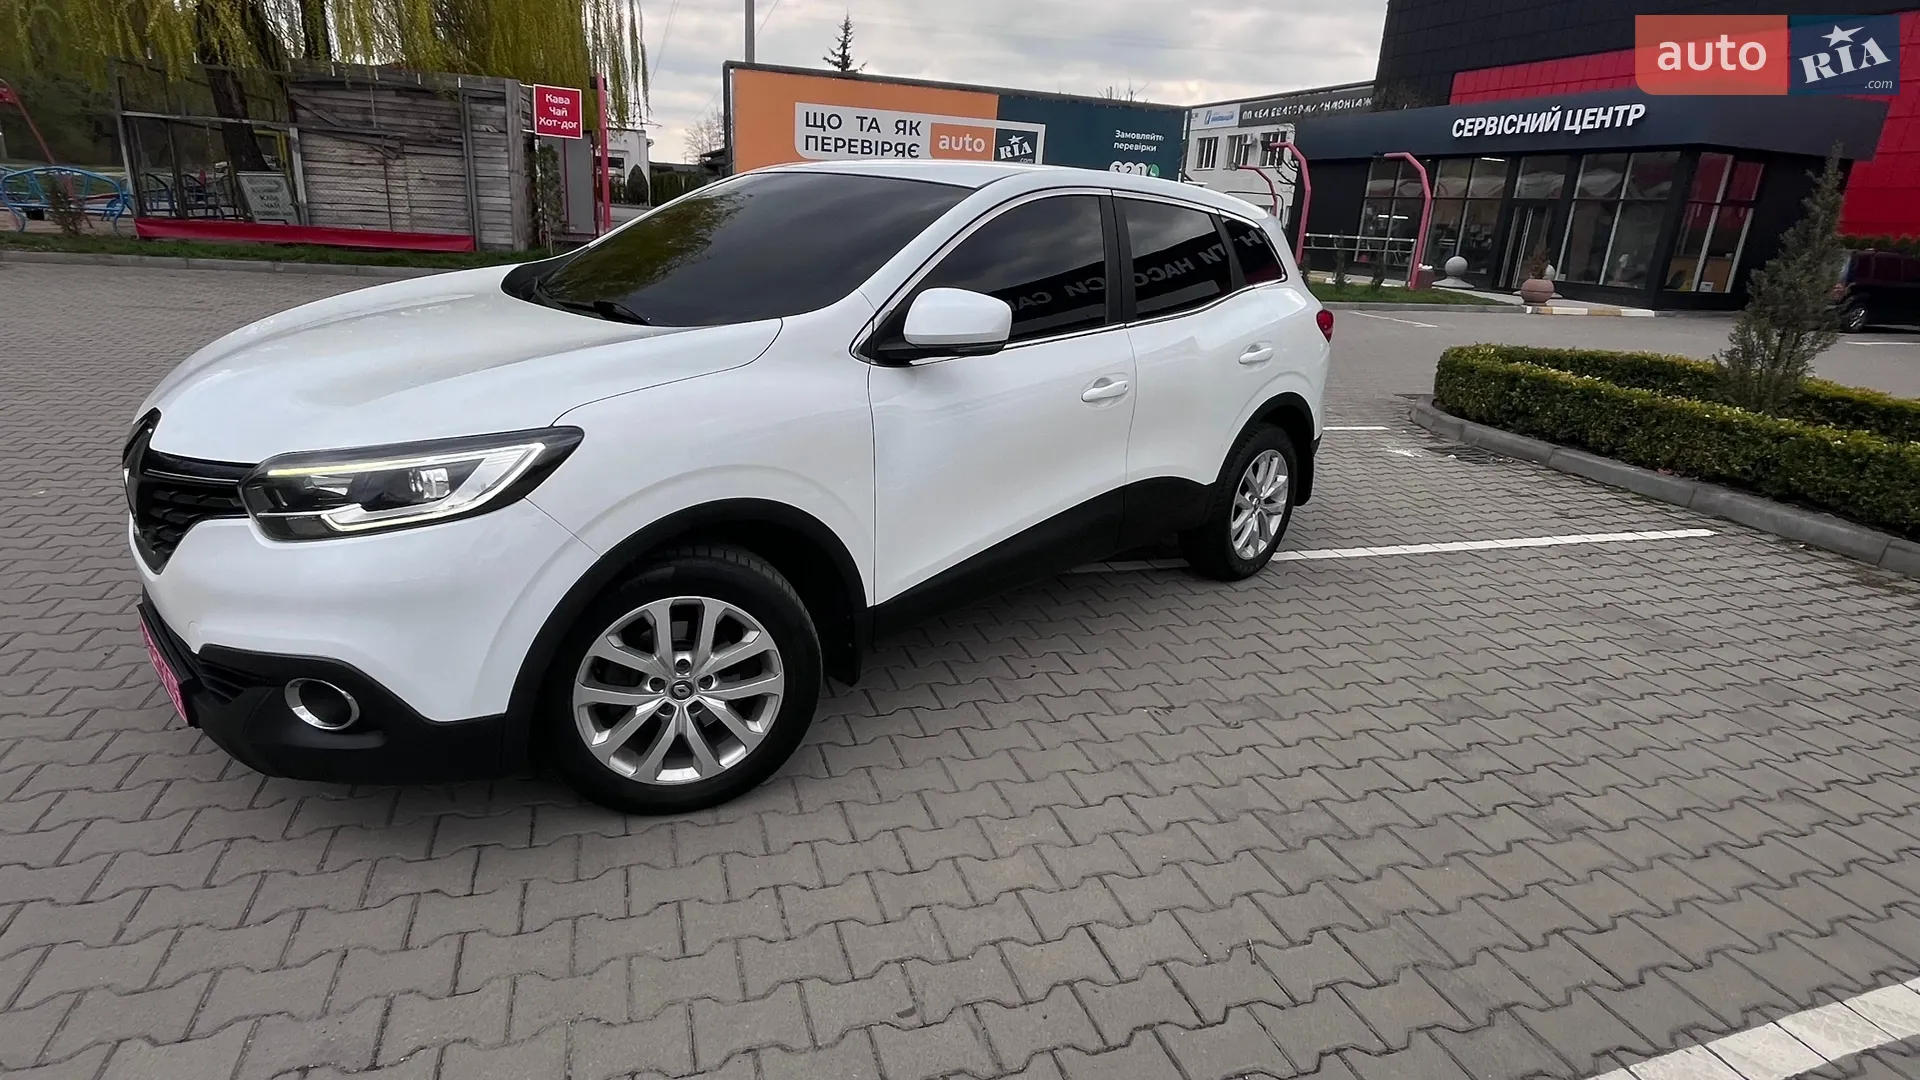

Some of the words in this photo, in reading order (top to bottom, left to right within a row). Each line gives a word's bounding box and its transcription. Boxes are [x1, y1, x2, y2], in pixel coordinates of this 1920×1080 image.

[545, 93, 570, 105] Кава
[548, 106, 568, 117] Чай
[1452, 105, 1561, 138] СЕРВІСНИЙ
[1564, 103, 1646, 135] ЦЕНТР
[538, 116, 578, 130] Хот-дог
[805, 111, 842, 132] ЩО
[855, 115, 881, 133] ТА
[894, 119, 921, 136] ЯК
[804, 134, 920, 158] ПЕРЕВІРЯЄ
[938, 133, 986, 153] auto
[999, 141, 1033, 160] RIA
[1113, 142, 1157, 152] перевірки
